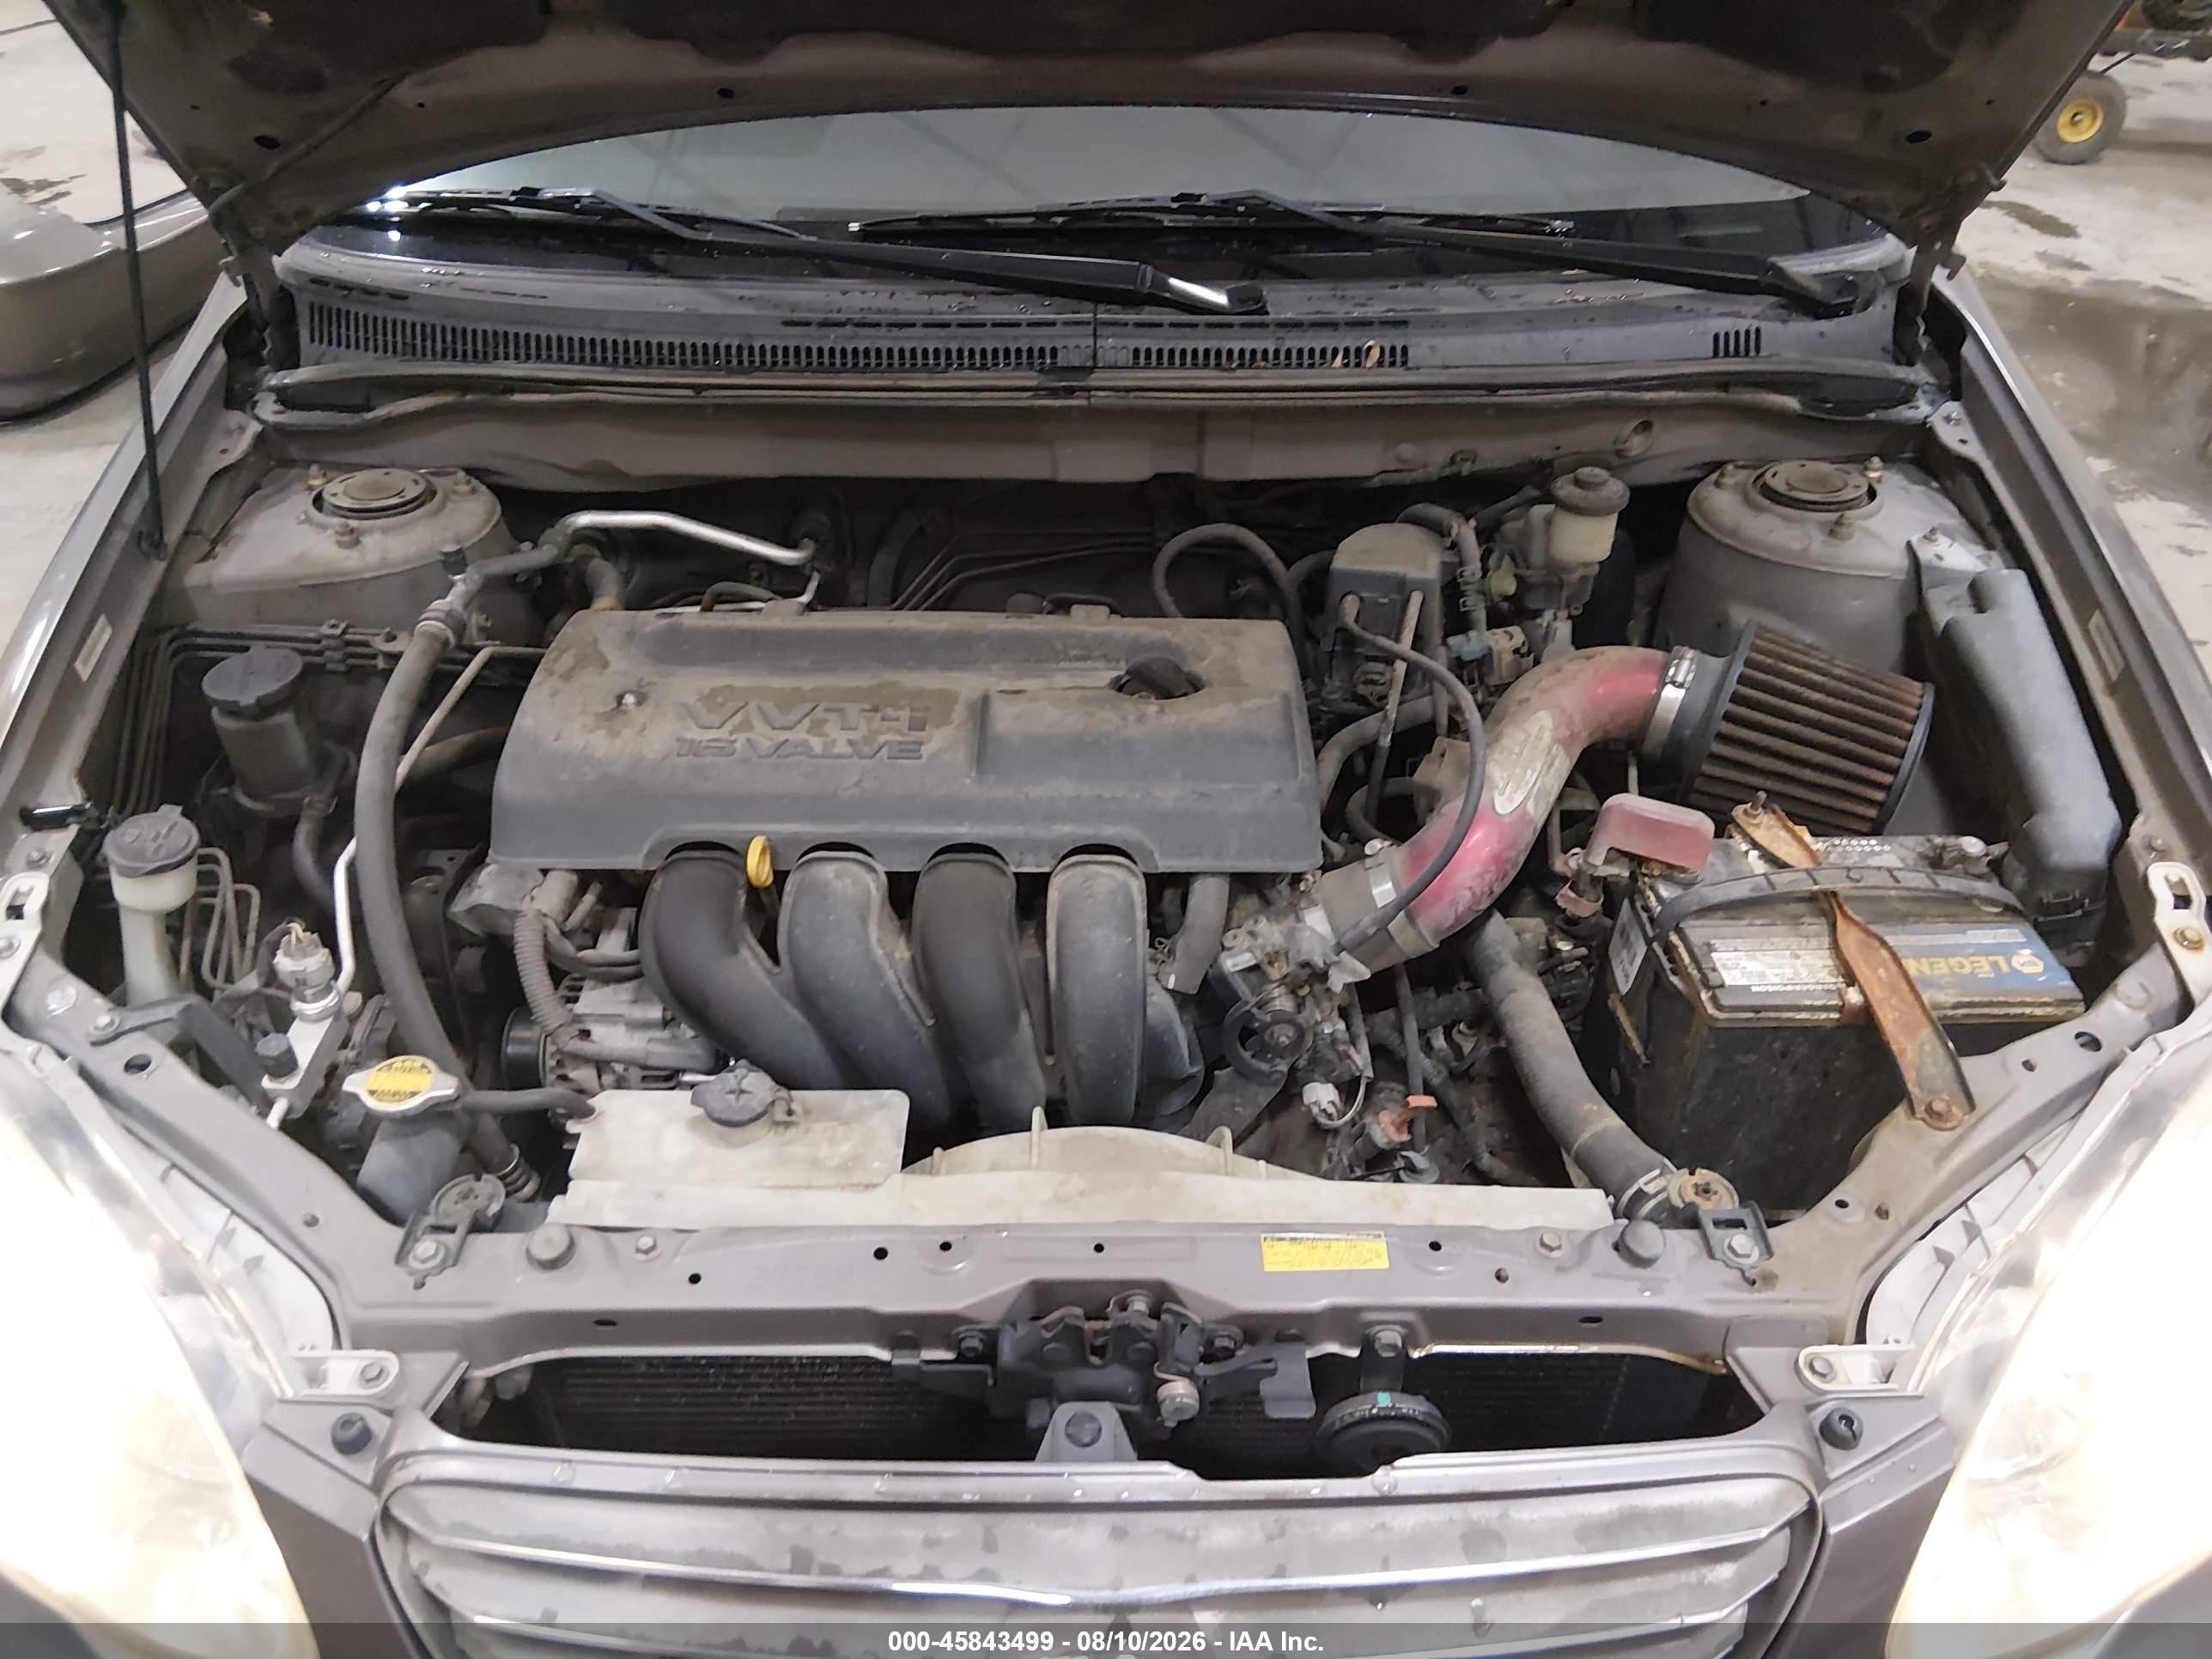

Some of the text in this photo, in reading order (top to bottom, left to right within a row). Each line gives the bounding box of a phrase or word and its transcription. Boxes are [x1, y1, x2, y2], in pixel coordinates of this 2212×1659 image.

[675, 736, 925, 760] 16 VALVE
[1900, 955, 2010, 976] LEGEN
